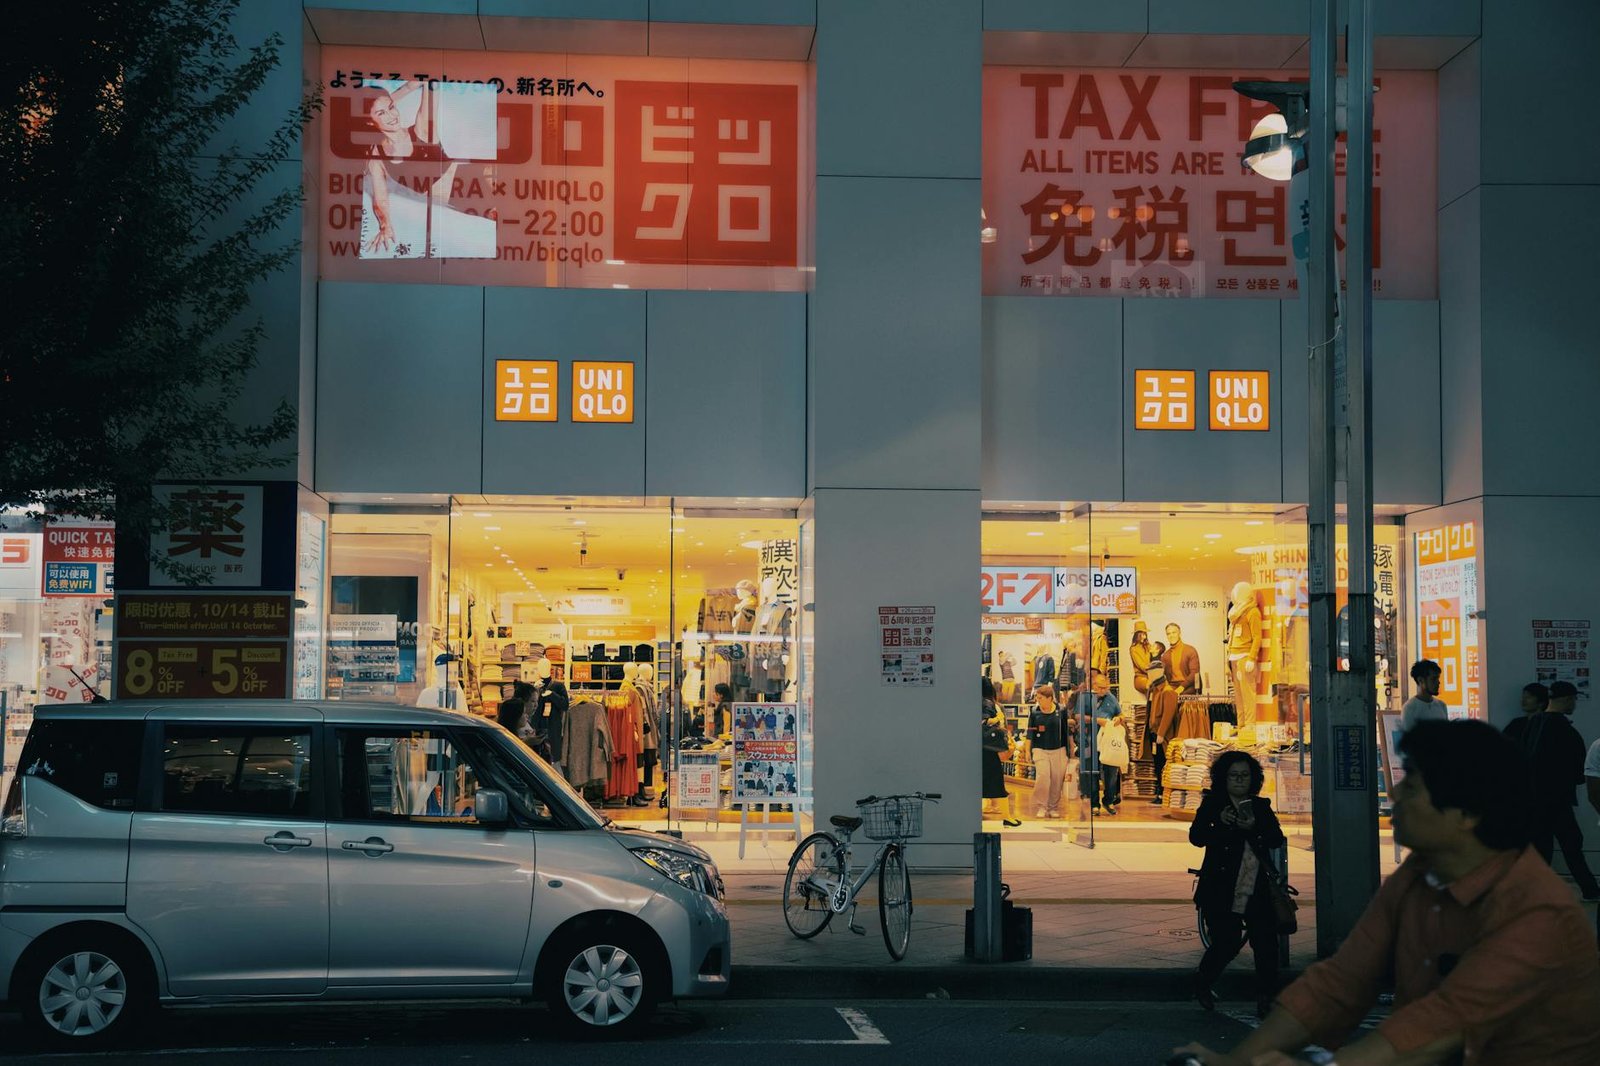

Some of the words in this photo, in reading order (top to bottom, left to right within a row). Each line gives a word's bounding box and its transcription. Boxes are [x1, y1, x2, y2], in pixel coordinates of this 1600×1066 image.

[1020, 73, 1162, 141] TAX
[1188, 75, 1382, 143] FR
[1020, 149, 1073, 174] ALL
[1085, 150, 1159, 175] ITEMS
[1171, 152, 1224, 176] ARE
[515, 179, 604, 205] UNIQLO
[1020, 182, 1195, 267] 免税
[1216, 278, 1239, 291] 모든
[504, 368, 550, 389] ユニ
[579, 369, 623, 391] UNI
[1143, 377, 1188, 398] ユニ
[1216, 378, 1258, 399] UNI
[502, 393, 550, 414] クロ
[579, 393, 627, 418] QLO
[1142, 402, 1187, 423] クロ
[1216, 402, 1263, 426] QLO
[48, 531, 89, 546] QUICK
[94, 531, 115, 545] TA
[49, 569, 90, 579] 可以使用
[1093, 573, 1133, 588] BABY
[125, 649, 154, 695] 8
[158, 666, 174, 681] %
[212, 649, 239, 695] 5
[242, 666, 258, 680] %
[157, 680, 185, 693] OFF
[242, 680, 268, 693] OFF
